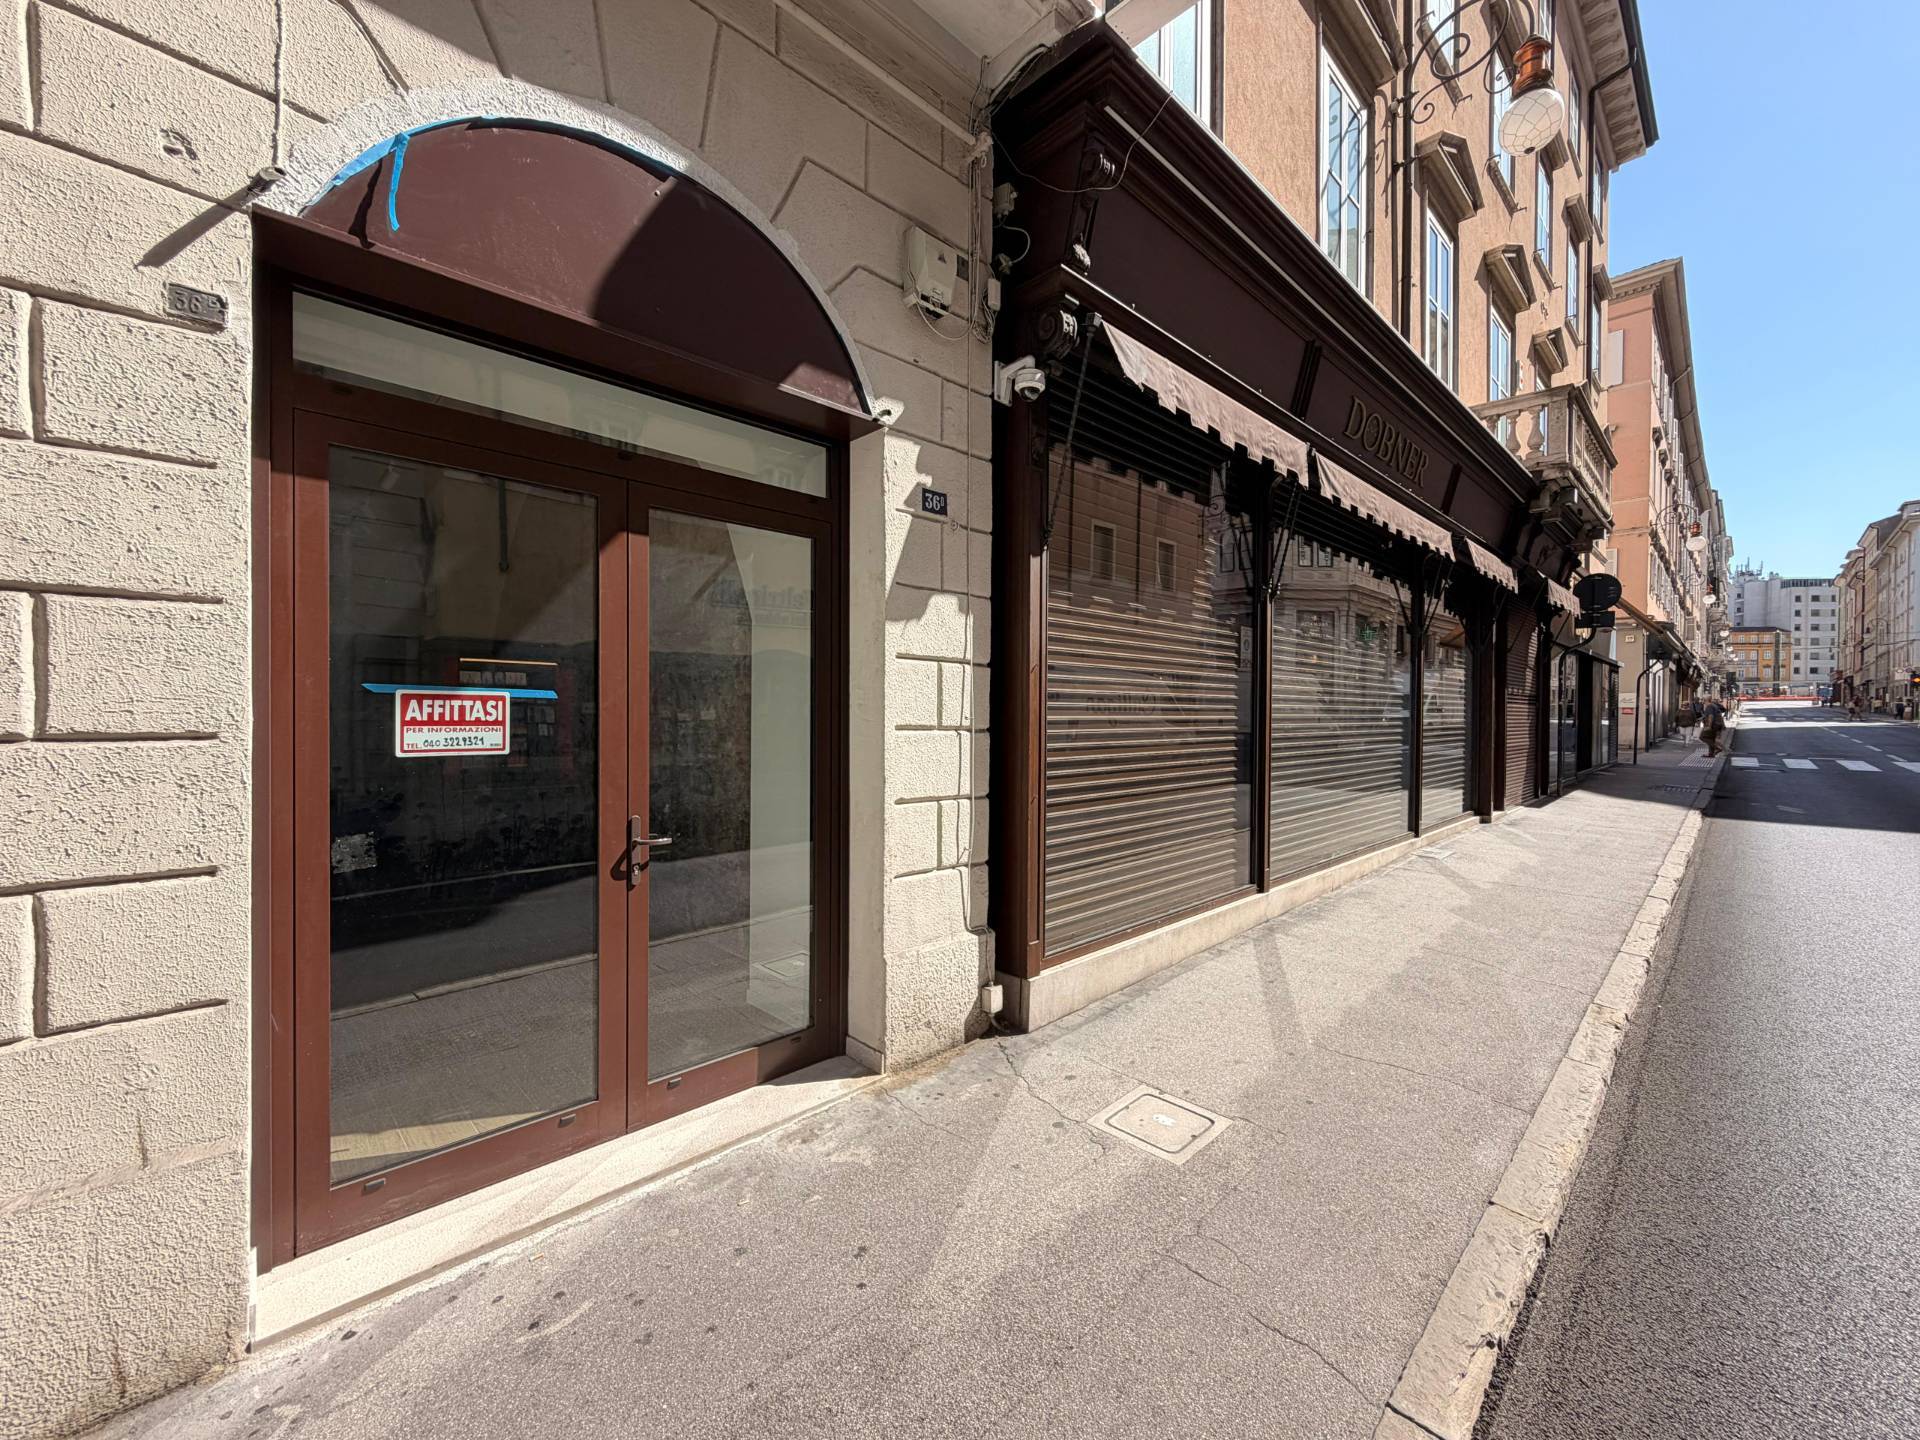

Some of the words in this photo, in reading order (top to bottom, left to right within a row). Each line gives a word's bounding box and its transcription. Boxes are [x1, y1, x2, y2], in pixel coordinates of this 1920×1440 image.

[1343, 395, 1429, 487] DOBNER
[404, 699, 503, 721] AFFITTASI
[423, 739, 441, 748] 040
